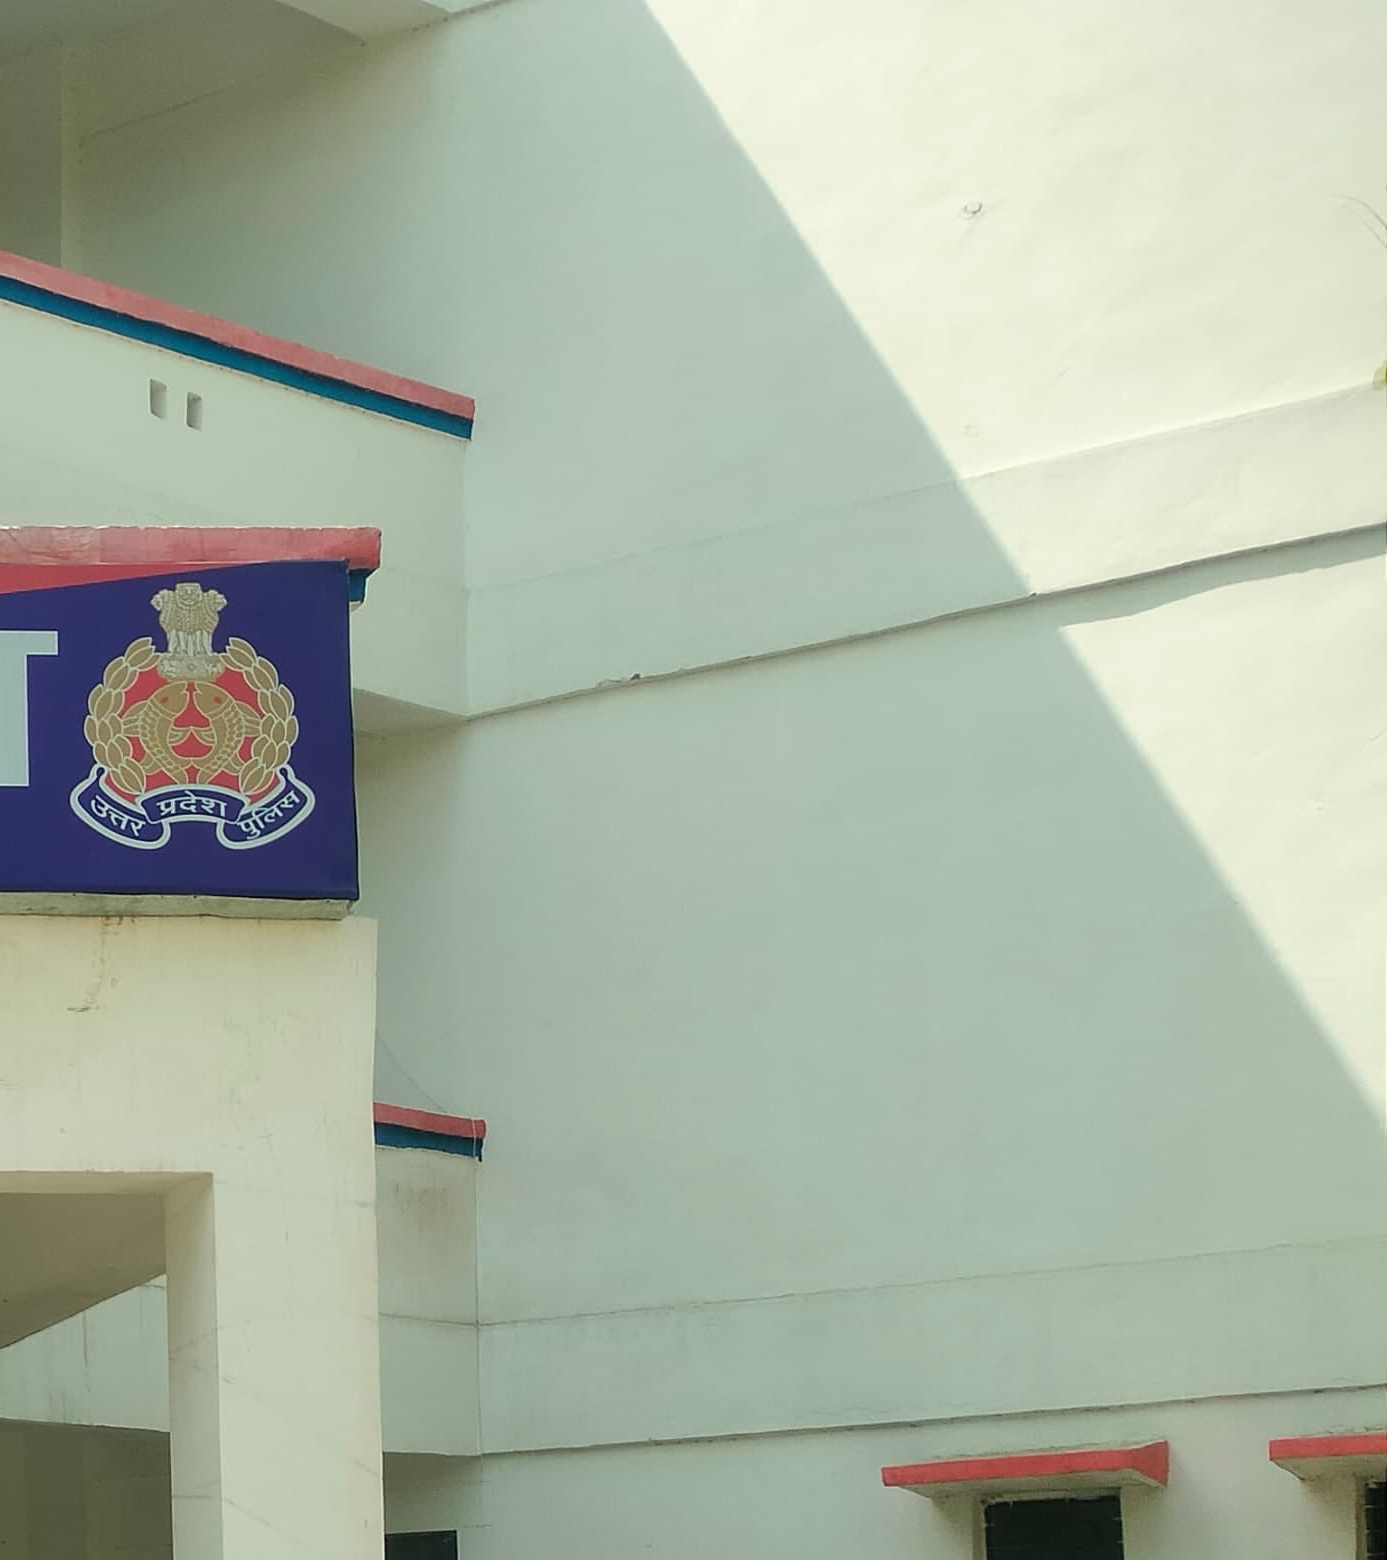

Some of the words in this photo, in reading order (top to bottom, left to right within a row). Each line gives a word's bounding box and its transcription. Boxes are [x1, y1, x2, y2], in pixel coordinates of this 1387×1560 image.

[90, 795, 146, 837] उत्तर
[156, 790, 228, 817] प्रदेश
[237, 790, 301, 840] पुलिस
